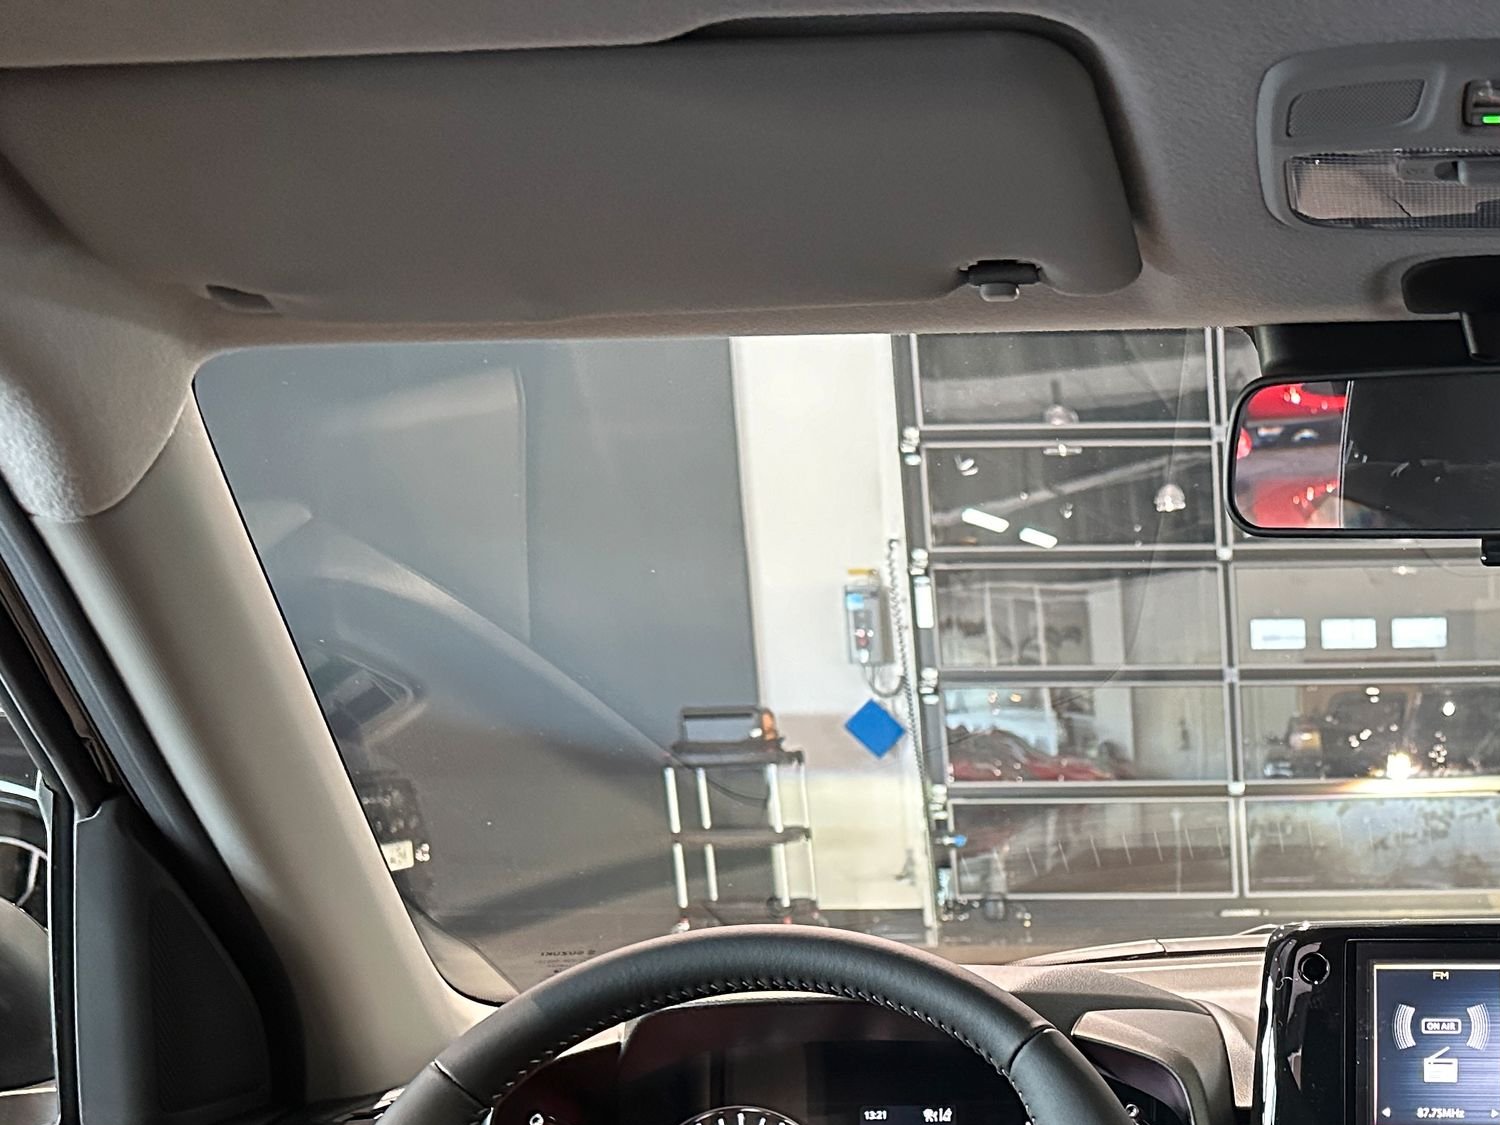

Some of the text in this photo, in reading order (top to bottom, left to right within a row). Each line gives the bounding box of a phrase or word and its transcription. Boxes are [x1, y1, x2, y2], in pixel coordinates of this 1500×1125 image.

[1432, 971, 1449, 980] FM
[1426, 1021, 1456, 1031] ON AIR
[864, 1110, 887, 1120] 13:21
[1416, 1107, 1465, 1118] 87.75MHz
